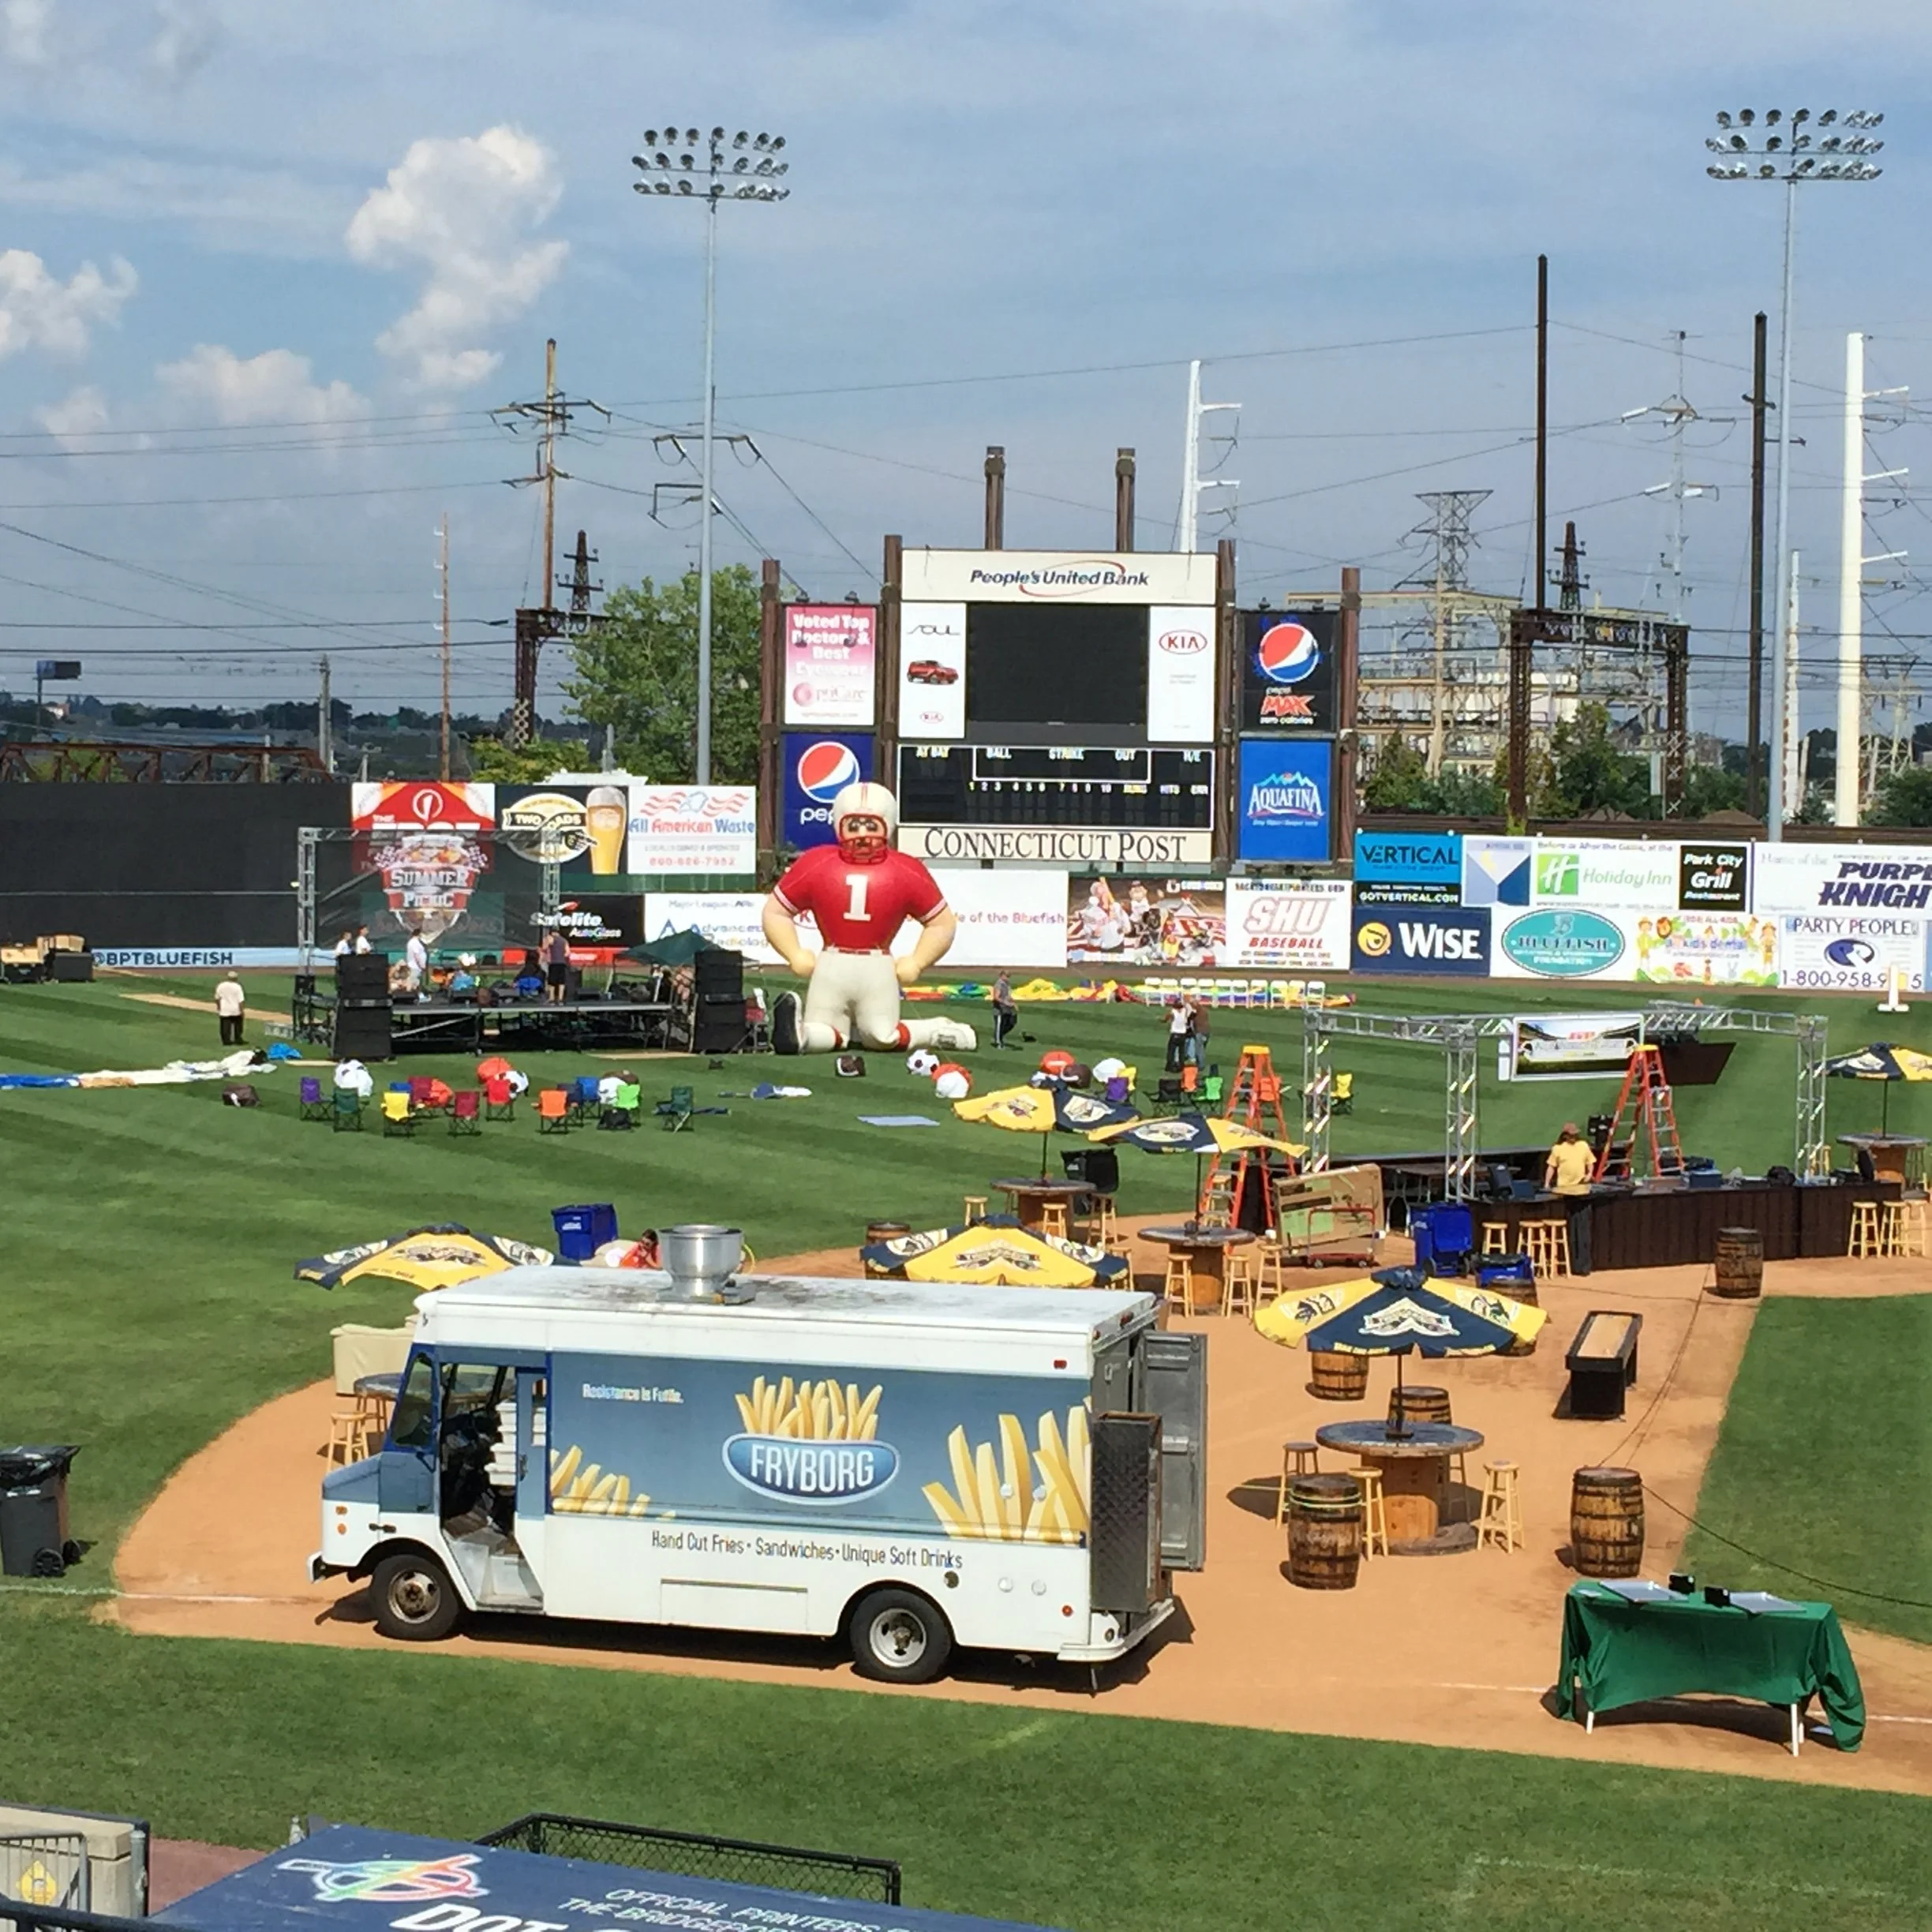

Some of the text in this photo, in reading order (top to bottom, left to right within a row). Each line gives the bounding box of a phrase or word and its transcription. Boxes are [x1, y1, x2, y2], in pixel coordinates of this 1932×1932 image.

[970, 569, 1149, 587] People's United Bank
[792, 613, 870, 632] Voted Top
[857, 631, 871, 645] &
[1168, 635, 1200, 650] KIA
[811, 646, 850, 660] Best
[1260, 695, 1316, 717] MAX
[986, 747, 1012, 759] BALL
[1114, 749, 1136, 761] OUT
[1247, 784, 1325, 817] AQUAFINA
[515, 814, 542, 826] TWO
[799, 807, 834, 826] pep
[628, 818, 755, 834] All American Waste
[925, 828, 1187, 862] CONNECTICUT POST
[1360, 844, 1459, 864] VERTICAL
[1683, 853, 1744, 868] Park City
[391, 870, 469, 887] SUMMER
[1582, 867, 1672, 889] Holiday Inn
[1690, 871, 1734, 889] Grill
[843, 873, 872, 922] 1
[1359, 891, 1459, 903] GOTVERTICAL.COM
[529, 912, 603, 927] Safelite
[969, 911, 983, 923] of
[987, 912, 1009, 923] the
[1012, 912, 1065, 924] Bluefish
[1242, 896, 1337, 935] SHU
[1793, 918, 1844, 934] PARTY
[1849, 919, 1911, 936] PEOPLE
[1249, 937, 1324, 949] BASEBALL
[93, 951, 234, 966] @BPTBLUEFISH
[1781, 969, 1923, 990] 1-800-958-95
[751, 1443, 874, 1493] FRYBORG
[652, 1530, 964, 1570] Hand Cut Fries Sandwiches Unique Soft Drinks
[558, 1896, 622, 1916] THE
[605, 1888, 728, 1916] OFFICIAL
